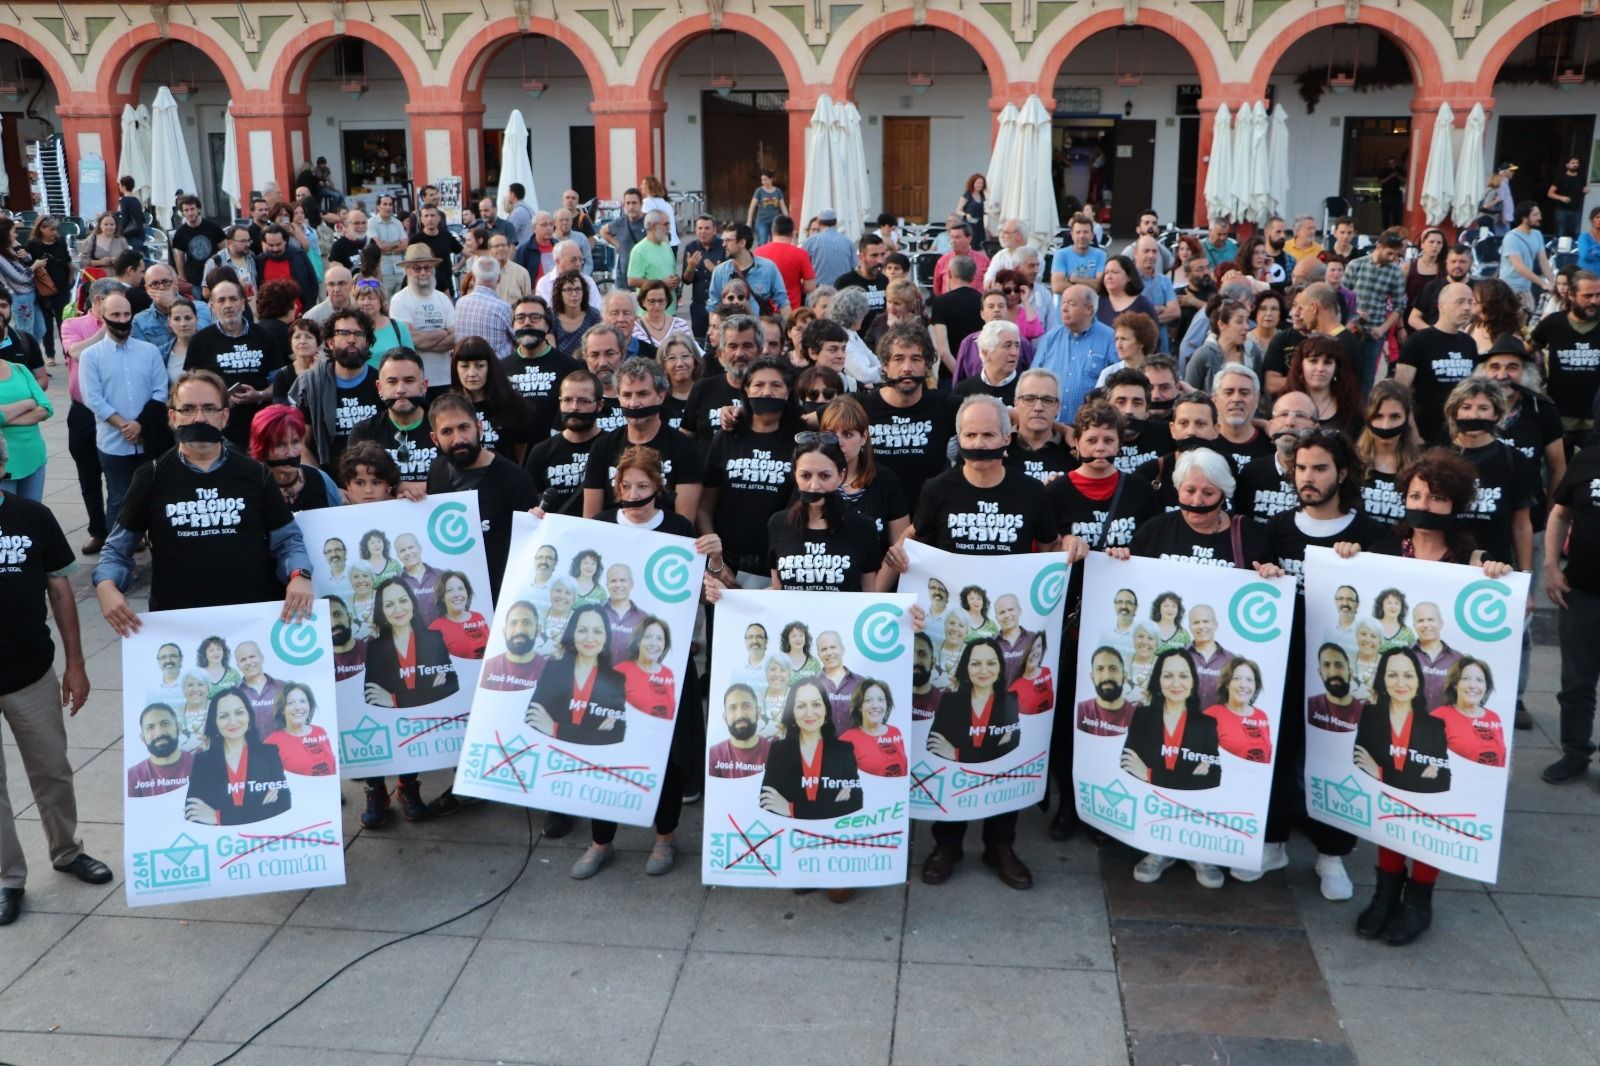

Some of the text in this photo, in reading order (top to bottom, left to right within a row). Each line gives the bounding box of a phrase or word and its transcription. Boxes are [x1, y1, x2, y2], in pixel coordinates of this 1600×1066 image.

[217, 350, 263, 362] DERECHOS
[342, 398, 358, 406] TUS
[891, 415, 911, 424] TUS
[868, 420, 933, 436] DERECHOS
[870, 435, 886, 445] DEL
[572, 452, 589, 463] TUS
[752, 449, 772, 459] TUS
[1121, 446, 1138, 456] TUS
[726, 458, 791, 473] DERECHOS
[1024, 461, 1043, 471] TUS
[728, 469, 742, 479] DEL
[1375, 480, 1394, 490] TUS
[195, 488, 218, 500] TUS
[166, 498, 245, 518] DERECHOS
[977, 501, 999, 513] TUS
[171, 515, 190, 527] DEL
[947, 513, 1024, 529] DERECHOS
[951, 526, 968, 538] DEL
[804, 542, 826, 555] TUS
[1192, 545, 1214, 558] TUS
[778, 554, 851, 570] DERECHOS
[780, 568, 795, 580] DEL
[464, 622, 476, 630] Ana
[337, 663, 365, 673] Manuel
[418, 663, 455, 676] Teresa
[487, 673, 537, 688] José Manuel
[252, 698, 274, 707] Rafael
[829, 693, 851, 701] Rafael
[590, 701, 627, 720] Teresa
[912, 708, 935, 718] anuel
[1082, 717, 1128, 734] José Manuel
[1313, 712, 1357, 730] José Manuel
[988, 722, 1021, 736] Teresa
[303, 736, 317, 744] Ana
[877, 736, 891, 744] Ana
[351, 743, 384, 758] vota
[408, 741, 427, 758] en
[1181, 748, 1221, 765] Teresa
[464, 743, 483, 779] 26M
[715, 760, 765, 772] José Manuel
[1409, 749, 1451, 769] Teresa
[546, 749, 658, 789] Ganemos
[951, 757, 1045, 789] Ganemos
[134, 775, 190, 789] José Manuel
[227, 780, 289, 794] Mª Teresa
[801, 776, 862, 789] Mª Teresa
[551, 780, 643, 811] en común
[958, 781, 1036, 808] en común
[1311, 776, 1324, 810] 26M
[834, 801, 906, 830] GENTE
[1098, 805, 1128, 823] vota
[1143, 794, 1258, 835] Ganemos
[1333, 799, 1363, 819] vota
[1378, 794, 1493, 840] Ganemos
[216, 828, 336, 857] Ganemos
[789, 829, 903, 850] Ganemos
[1151, 824, 1245, 856] en común
[1386, 821, 1479, 864] en común
[710, 832, 724, 868] 26M
[133, 853, 150, 889] 26M
[228, 853, 327, 881] en común
[798, 854, 892, 873] en común
[161, 863, 200, 880] vota
